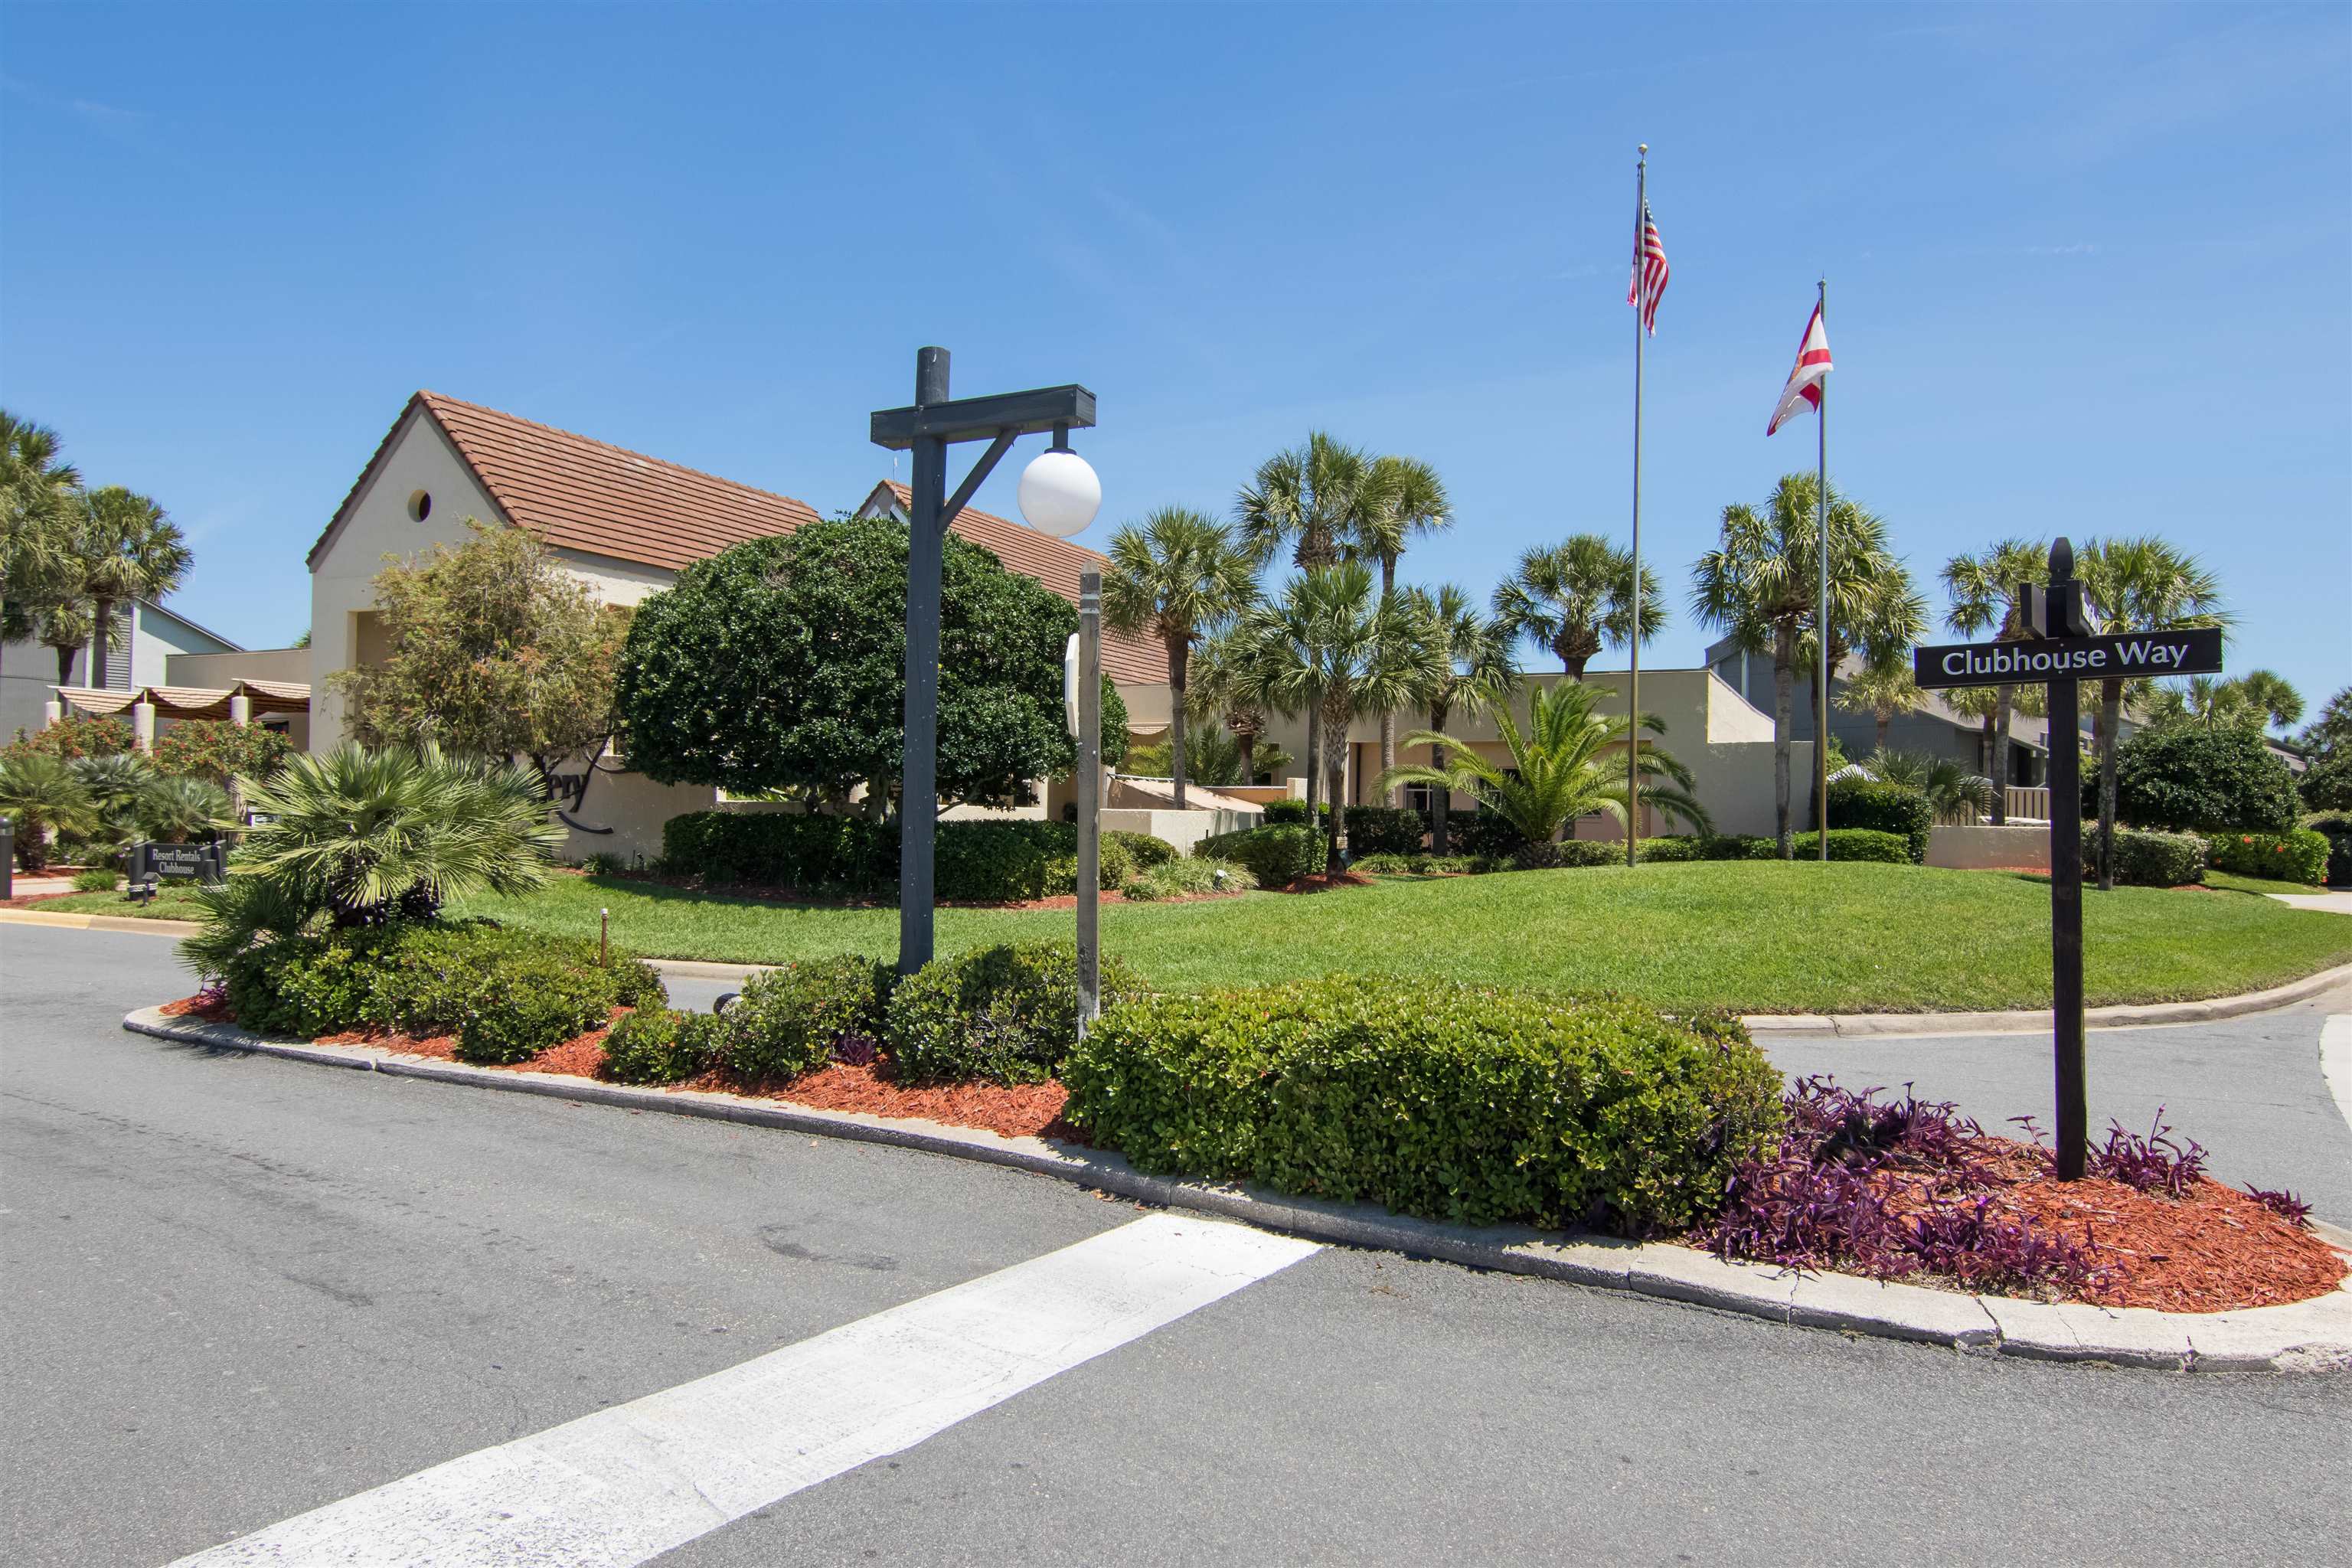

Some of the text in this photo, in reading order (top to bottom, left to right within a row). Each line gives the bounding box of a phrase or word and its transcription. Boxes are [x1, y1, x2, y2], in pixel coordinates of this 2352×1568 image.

[1942, 640, 2188, 675] Clubhouse Way
[152, 848, 201, 862] Resort Rentals
[159, 862, 194, 874] Clubhouse
